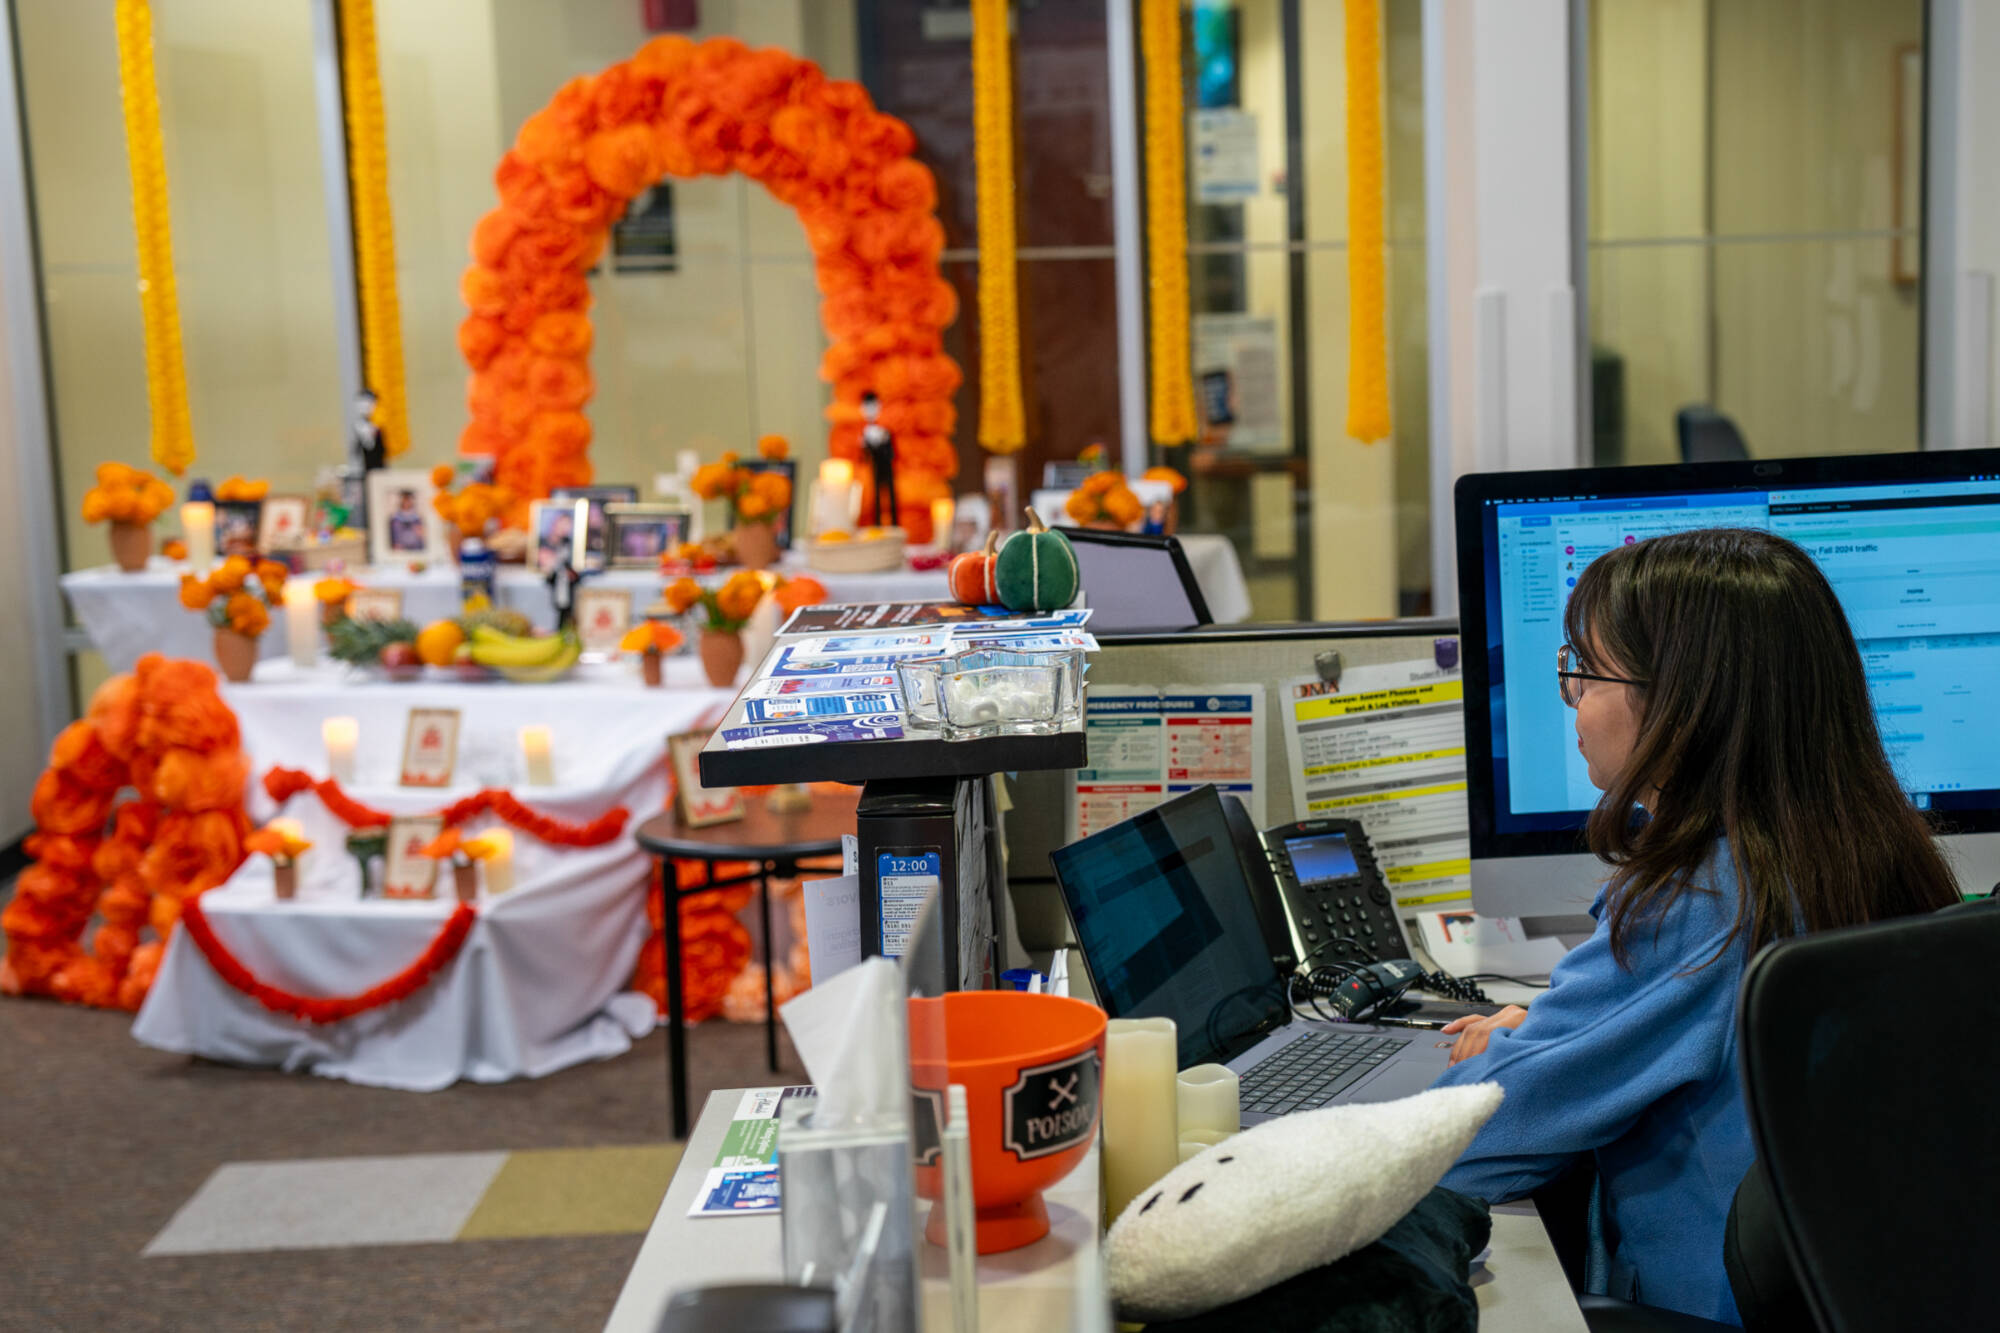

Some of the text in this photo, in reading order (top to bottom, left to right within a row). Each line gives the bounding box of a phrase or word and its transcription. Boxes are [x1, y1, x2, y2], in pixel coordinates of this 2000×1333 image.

[1835, 545, 1853, 554] 2024
[1855, 543, 1879, 553] traffic
[890, 859, 928, 872] 12:00
[1026, 1103, 1092, 1144] POISON
